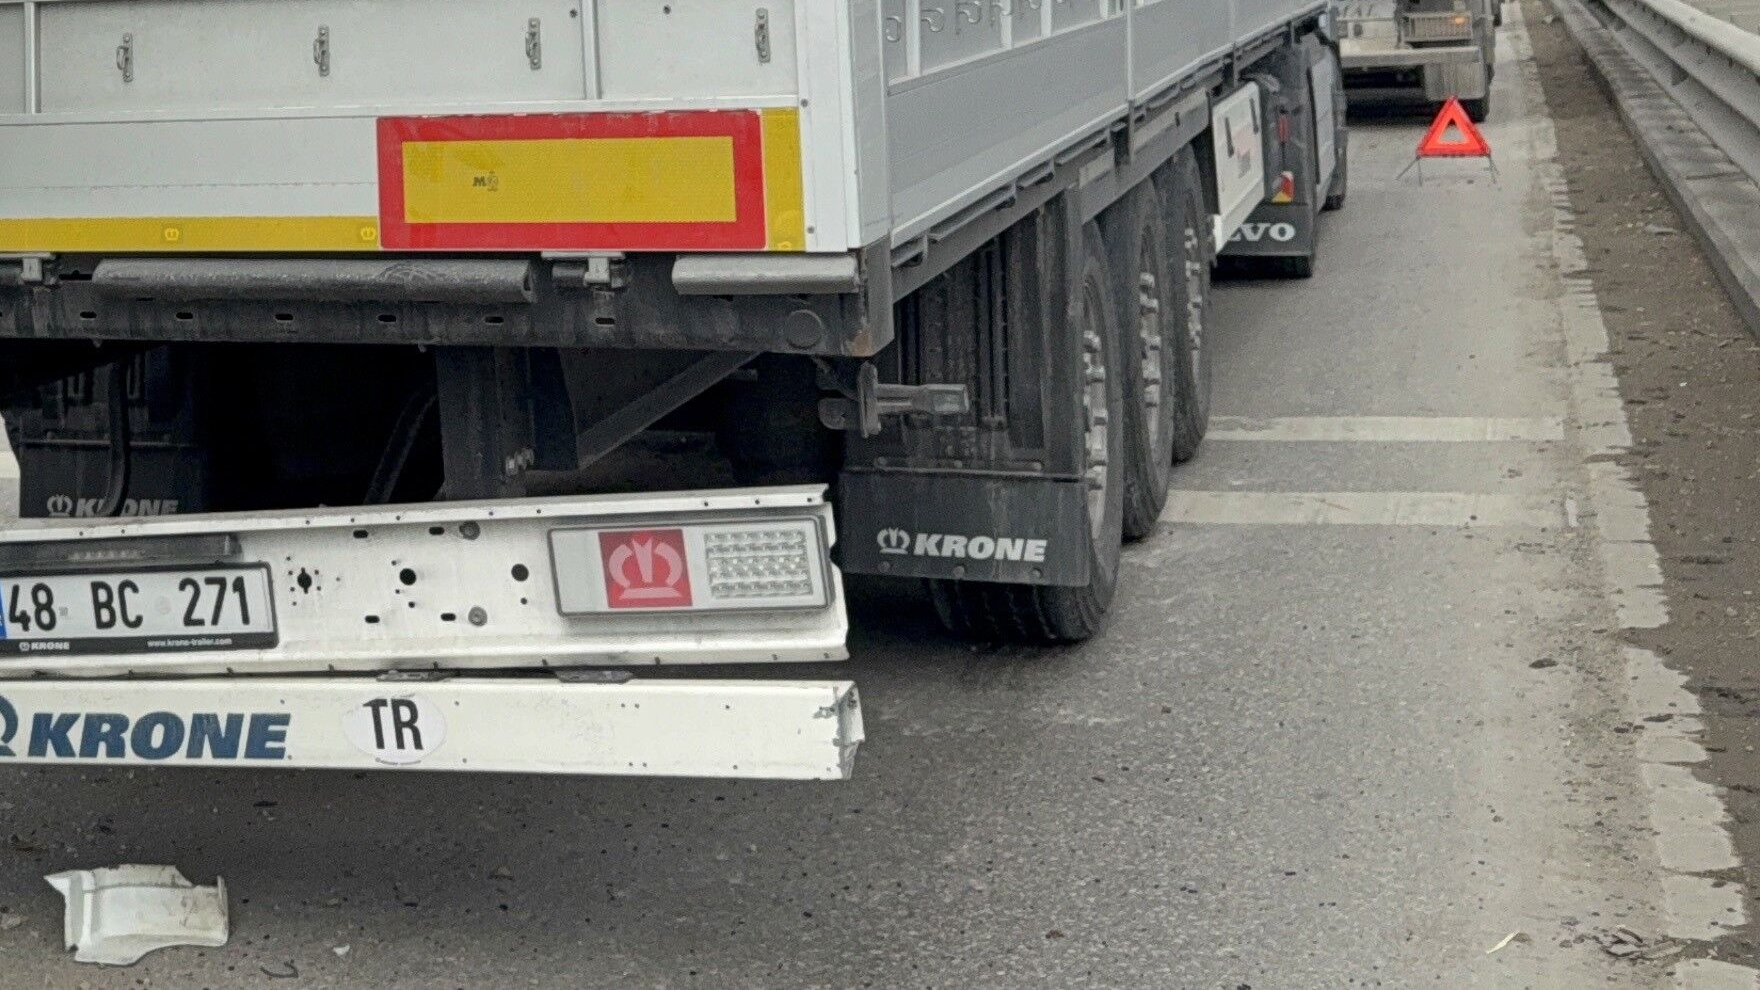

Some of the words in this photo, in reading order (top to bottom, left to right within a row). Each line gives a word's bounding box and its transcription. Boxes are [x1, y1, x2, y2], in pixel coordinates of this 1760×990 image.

[913, 533, 1048, 562] KRONE
[9, 583, 57, 631] 48
[90, 580, 143, 629] BC
[178, 576, 250, 627] 271
[31, 641, 70, 650] KRONE
[28, 711, 291, 759] KRONE
[362, 698, 424, 751] TR
